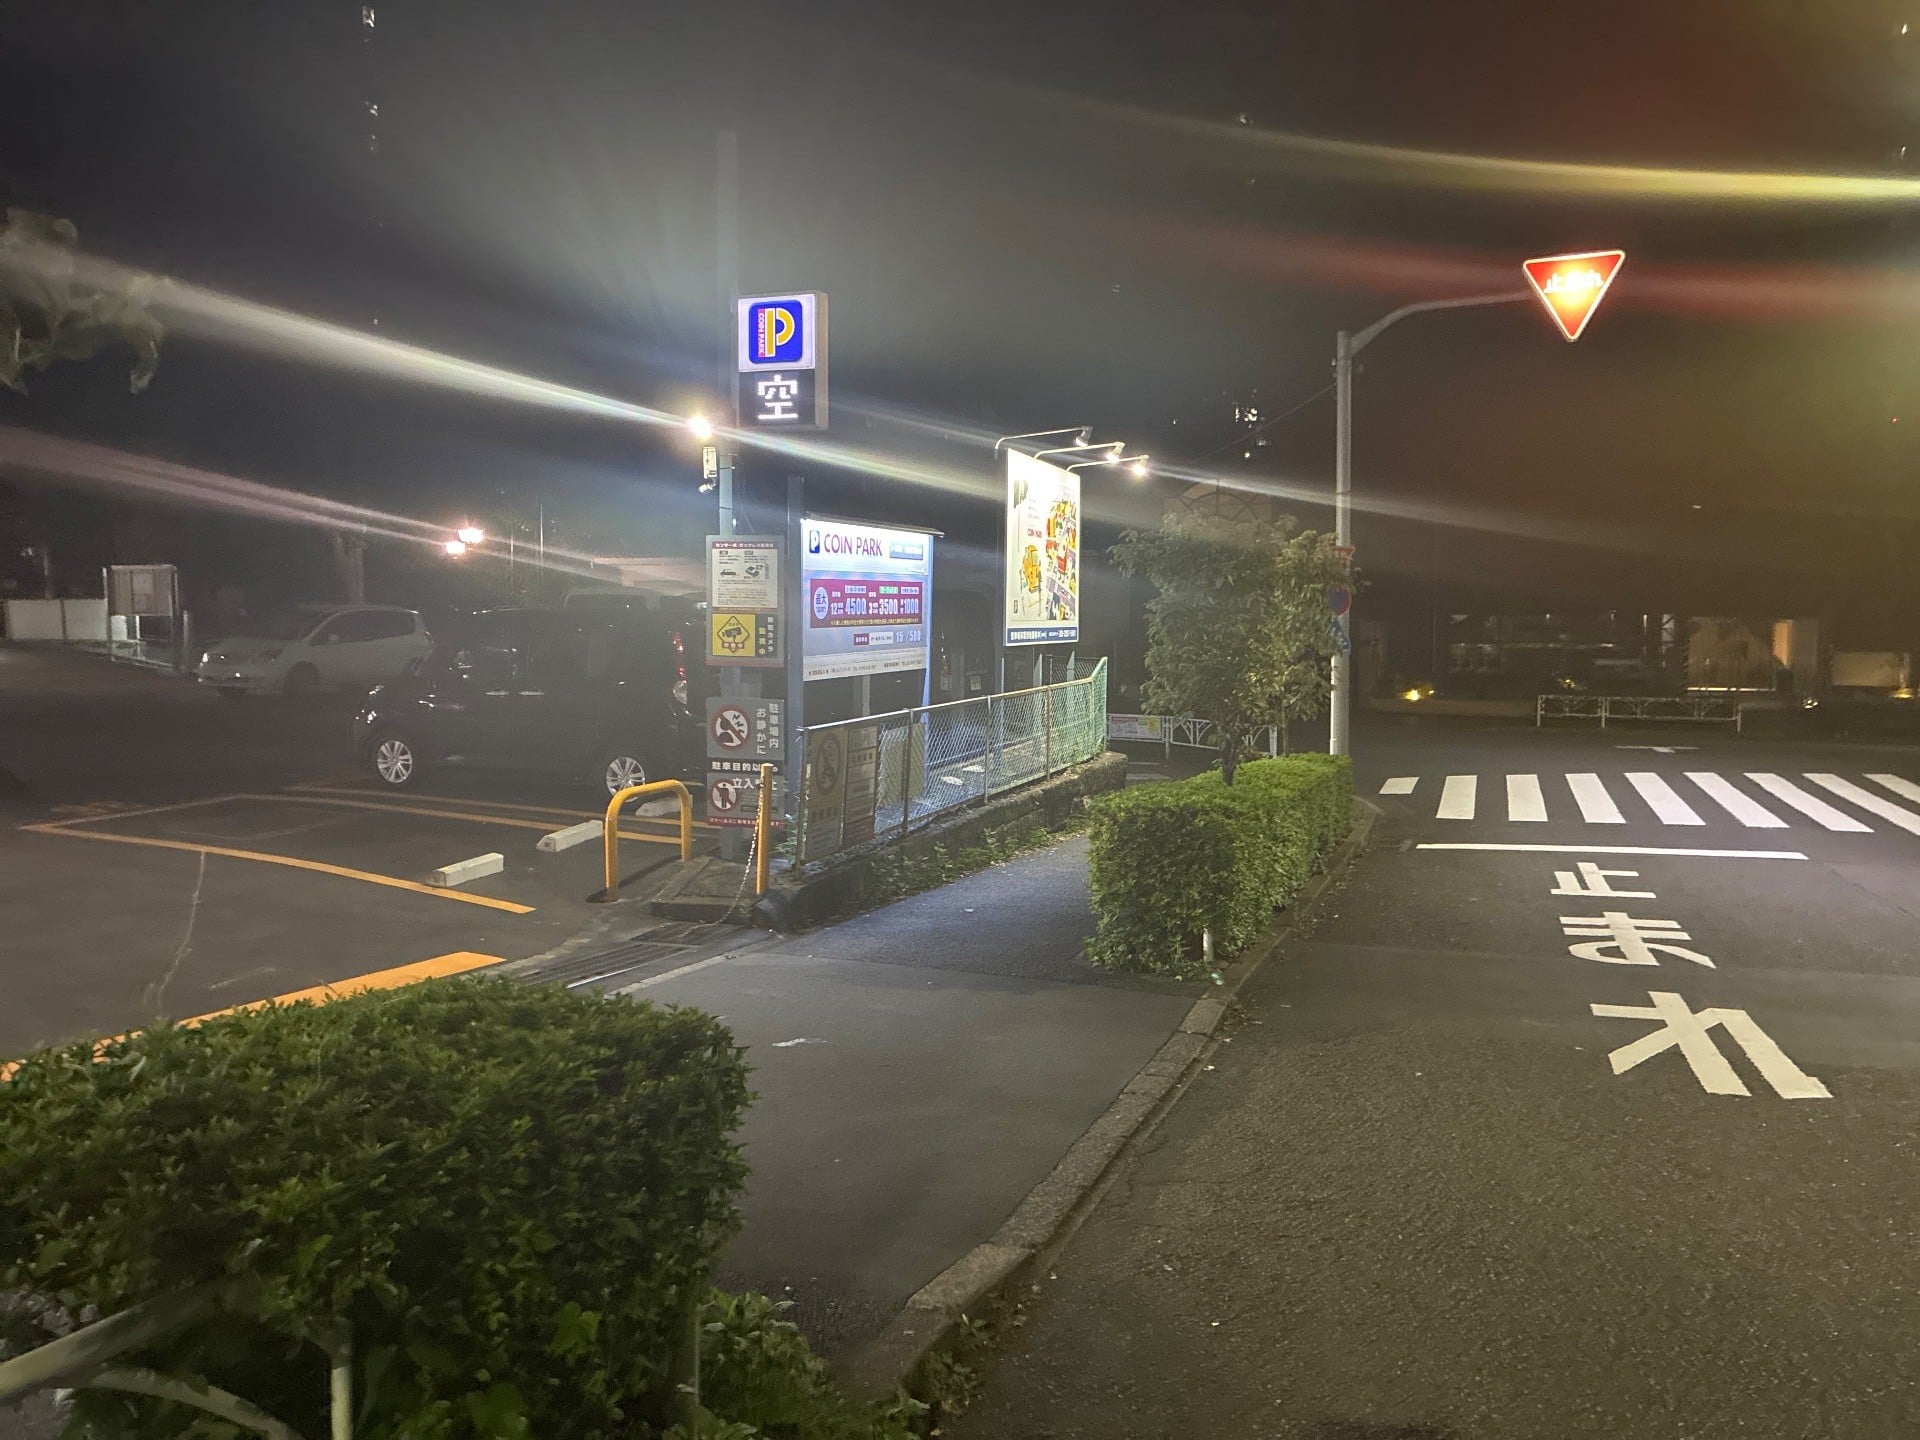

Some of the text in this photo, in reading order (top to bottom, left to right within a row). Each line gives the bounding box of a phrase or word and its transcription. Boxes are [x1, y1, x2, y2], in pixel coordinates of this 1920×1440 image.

[1543, 269, 1604, 293] 止れ
[765, 307, 795, 357] P
[757, 374, 798, 420] 空
[824, 534, 882, 556] COIN PARK
[845, 598, 866, 614] 4500
[879, 599, 897, 614] 3500
[904, 598, 919, 613] 1000
[756, 708, 767, 755] お静かに
[769, 703, 779, 749] 駐車場内
[712, 761, 778, 773] 駐車目的以の
[732, 778, 778, 791] 立入止
[1551, 862, 1833, 1099] 止まれ
